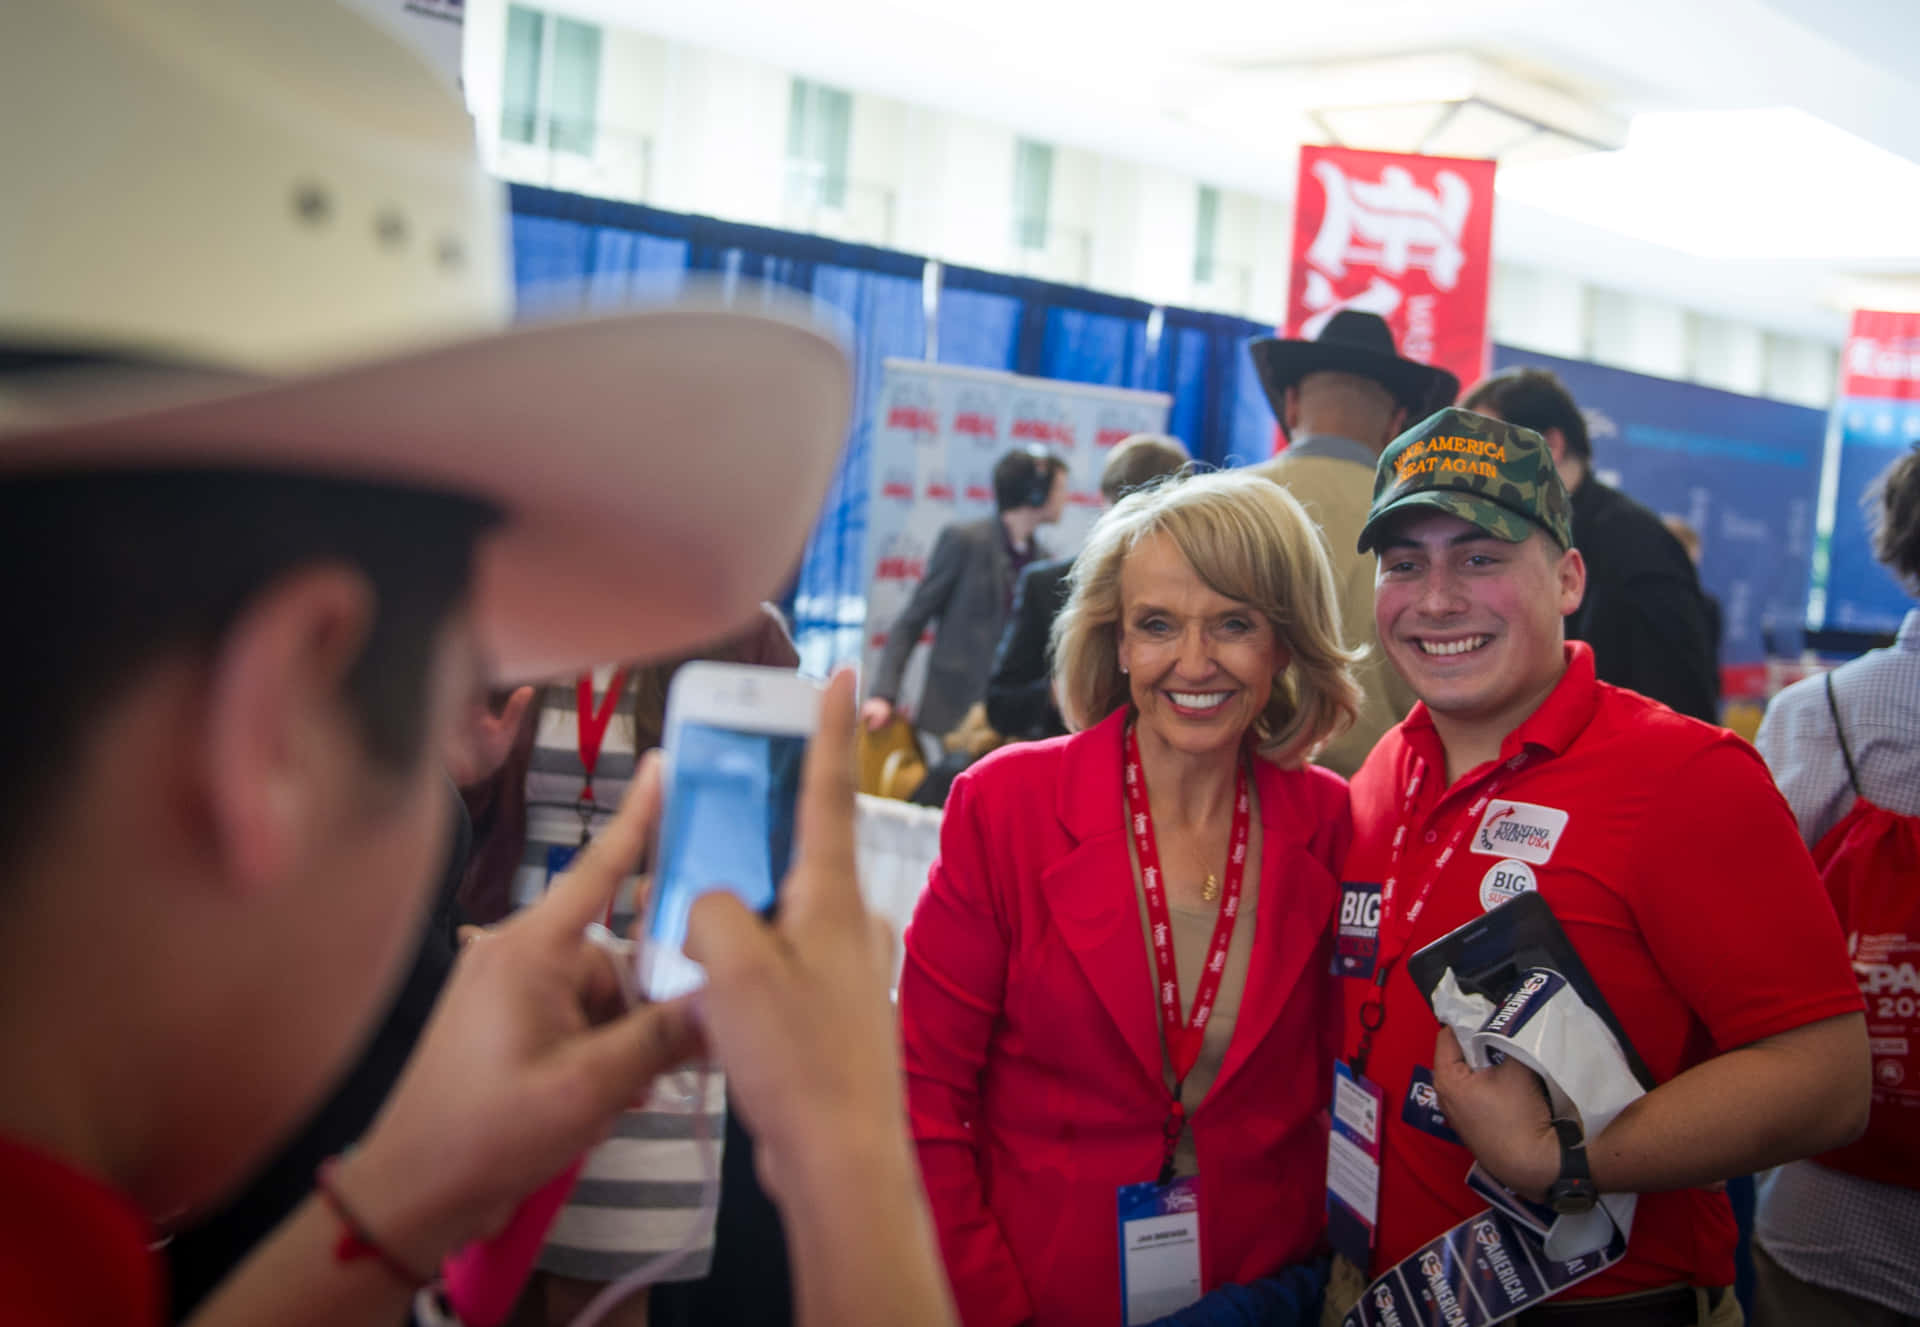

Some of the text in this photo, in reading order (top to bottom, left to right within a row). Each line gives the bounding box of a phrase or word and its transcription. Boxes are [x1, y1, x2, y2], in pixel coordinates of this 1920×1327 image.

[1427, 435, 1506, 463] AMERICA
[1440, 457, 1497, 478] AGAIN
[1494, 828, 1550, 850] POINT USA
[1500, 821, 1550, 838] TURNING
[1493, 871, 1527, 892] BIG
[1340, 891, 1382, 928] BIG
[1484, 1241, 1529, 1304] AMERICA!
